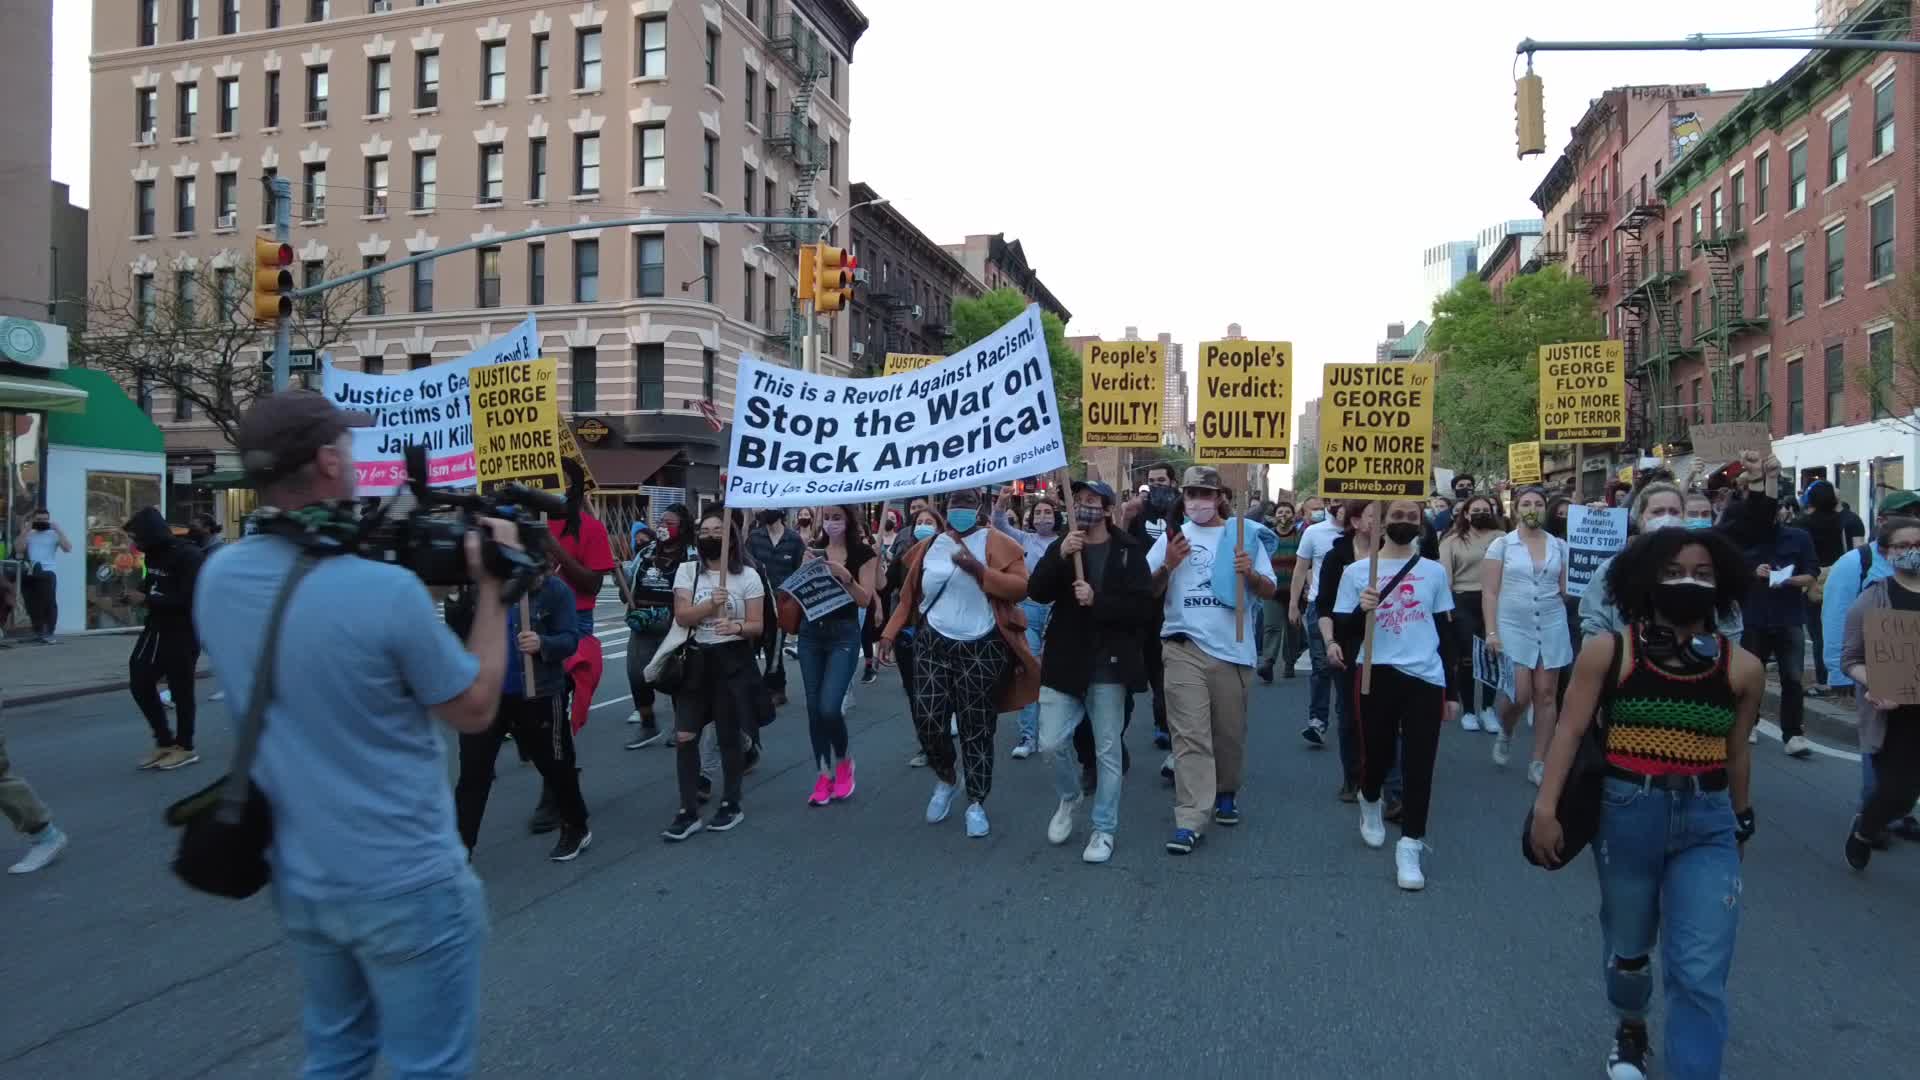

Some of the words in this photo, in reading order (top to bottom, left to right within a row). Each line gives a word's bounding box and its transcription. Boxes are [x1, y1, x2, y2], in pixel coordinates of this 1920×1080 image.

[753, 370, 795, 398] This
[800, 381, 817, 401] is
[824, 390, 836, 403] a
[843, 383, 903, 405] Revolt
[907, 360, 972, 399] Against
[977, 317, 1035, 373] Racism!
[1091, 345, 1157, 369] People's
[1207, 345, 1285, 373] People's
[1545, 345, 1601, 361] JUSTICE
[1606, 348, 1620, 358] for
[475, 365, 531, 389] JUSTICE
[536, 369, 551, 381] for
[1329, 367, 1404, 386] JUSTICE
[1410, 373, 1428, 386] for
[1548, 361, 1615, 376] GEORGE
[334, 383, 414, 405] Justice
[420, 380, 443, 400] for
[1091, 372, 1156, 391] Verdict:
[1207, 376, 1283, 398] Verdict:
[1557, 376, 1608, 391] FLOYD
[478, 385, 546, 408] GEORGE
[744, 396, 839, 445] Stop
[854, 409, 915, 437] the
[928, 381, 994, 425] War
[1004, 356, 1043, 396] on
[1333, 390, 1421, 407] GEORGE
[1558, 396, 1576, 409] NO
[1581, 394, 1620, 408] MORE
[446, 397, 460, 419] of
[487, 406, 538, 428] FLOYD
[1088, 401, 1158, 426] GUILTY!
[1342, 411, 1411, 427] FLOYD
[1545, 412, 1570, 425] COP
[1574, 410, 1621, 424] TERROR
[737, 435, 861, 473] Black
[873, 390, 1052, 471] America!
[1202, 410, 1285, 439] GUILTY!
[1557, 428, 1608, 439] pslweb.org
[422, 429, 443, 451] All
[479, 445, 487, 455] is
[490, 435, 506, 453] NO
[510, 430, 553, 449] MORE
[1326, 441, 1338, 453] is
[1342, 435, 1367, 453] NO
[1374, 436, 1425, 454] MORE
[480, 457, 503, 476] COP
[506, 451, 556, 472] TERROR
[730, 476, 779, 497] Party
[805, 479, 890, 494] Socialism
[920, 455, 1008, 485] Liberation
[1012, 438, 1060, 464] @pslweb
[1325, 456, 1358, 473] COP
[1364, 457, 1425, 475] TERROR
[1340, 480, 1406, 494] pslweb.org
[1570, 535, 1594, 544] MUST
[1574, 553, 1588, 564] We
